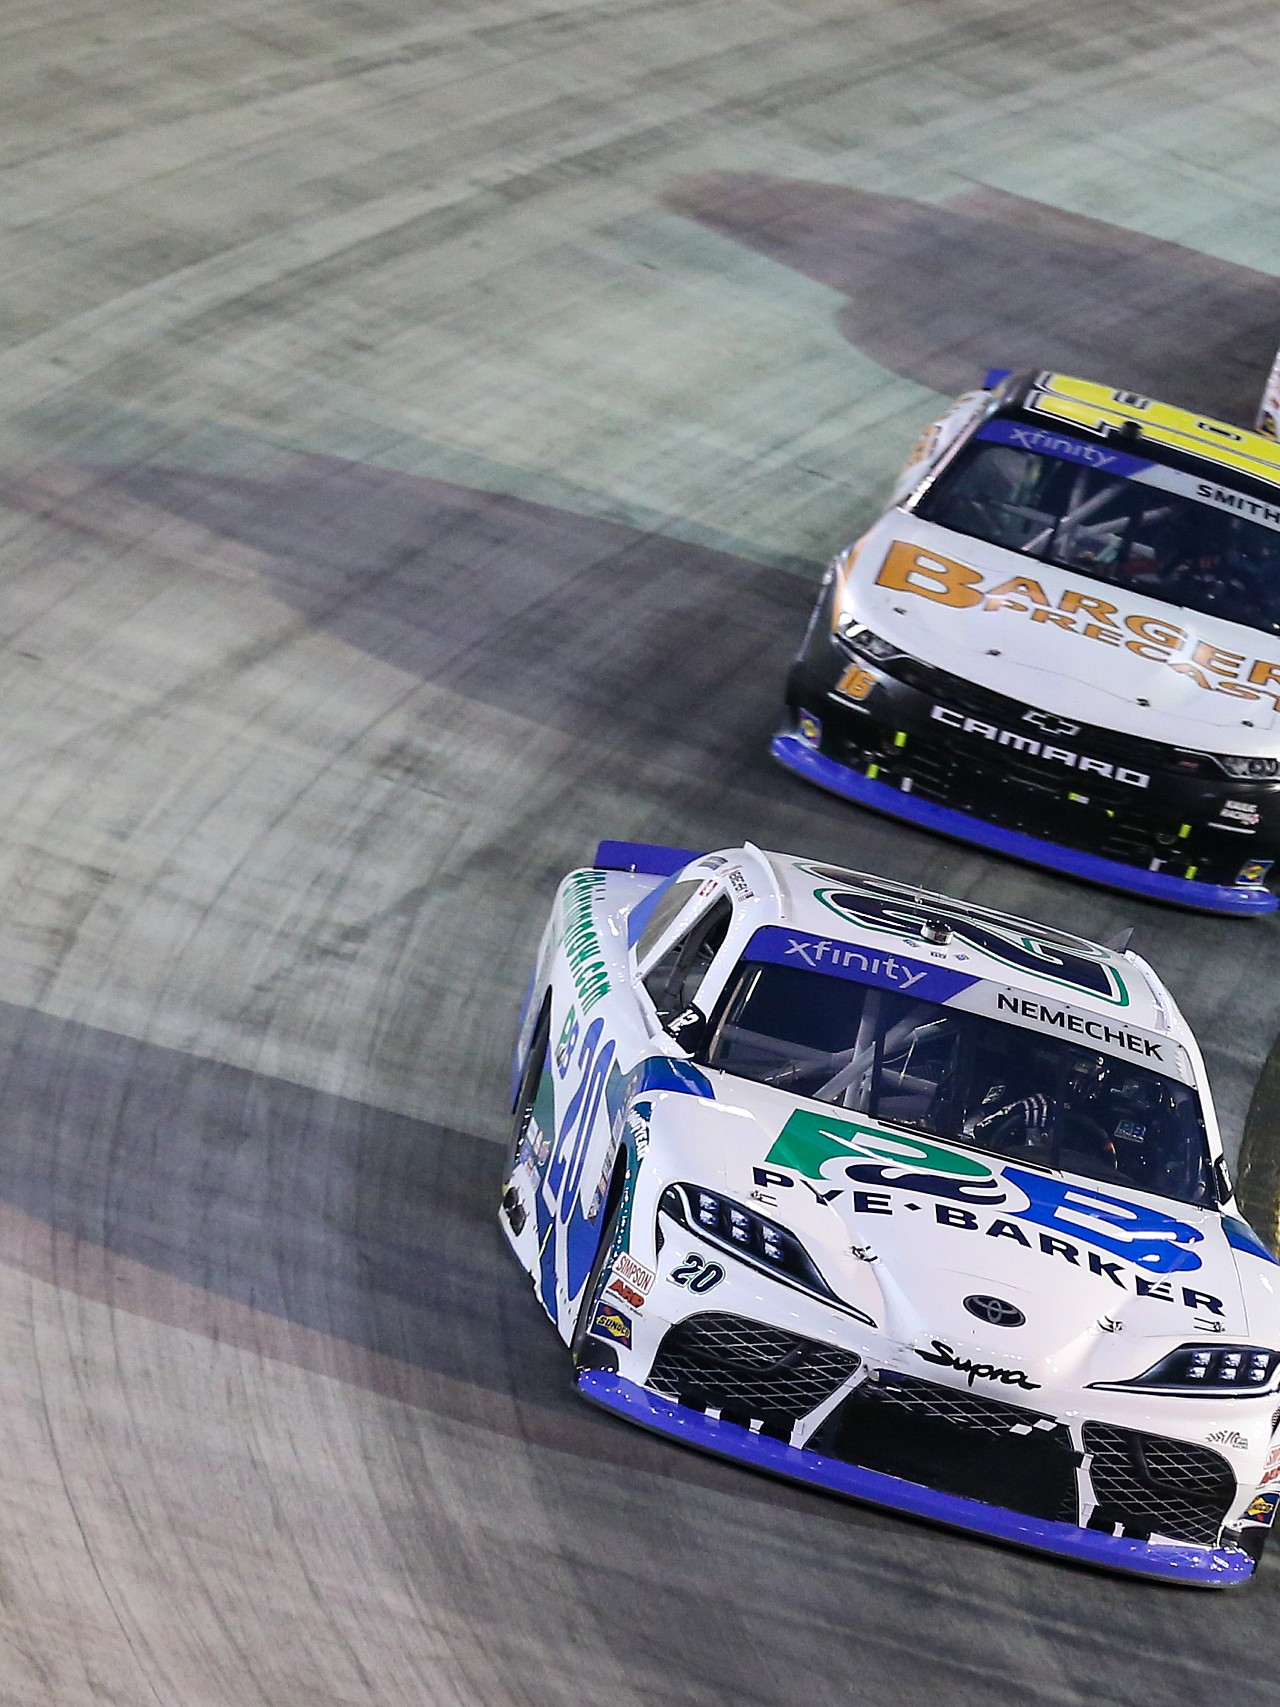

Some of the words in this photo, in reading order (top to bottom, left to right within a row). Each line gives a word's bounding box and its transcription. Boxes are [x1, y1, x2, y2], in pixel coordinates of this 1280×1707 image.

[1008, 425, 1117, 468] xfinity
[835, 662, 878, 701] 16
[931, 704, 1151, 789] CAMARO
[785, 937, 928, 989] xfinity
[996, 992, 1164, 1061] NEMECHEK
[615, 1255, 653, 1291] SIMPSON
[669, 1251, 722, 1292] 20
[608, 1279, 645, 1308] ARP
[598, 1316, 630, 1339] SUNOCO
[913, 1340, 1042, 1389] Supra
